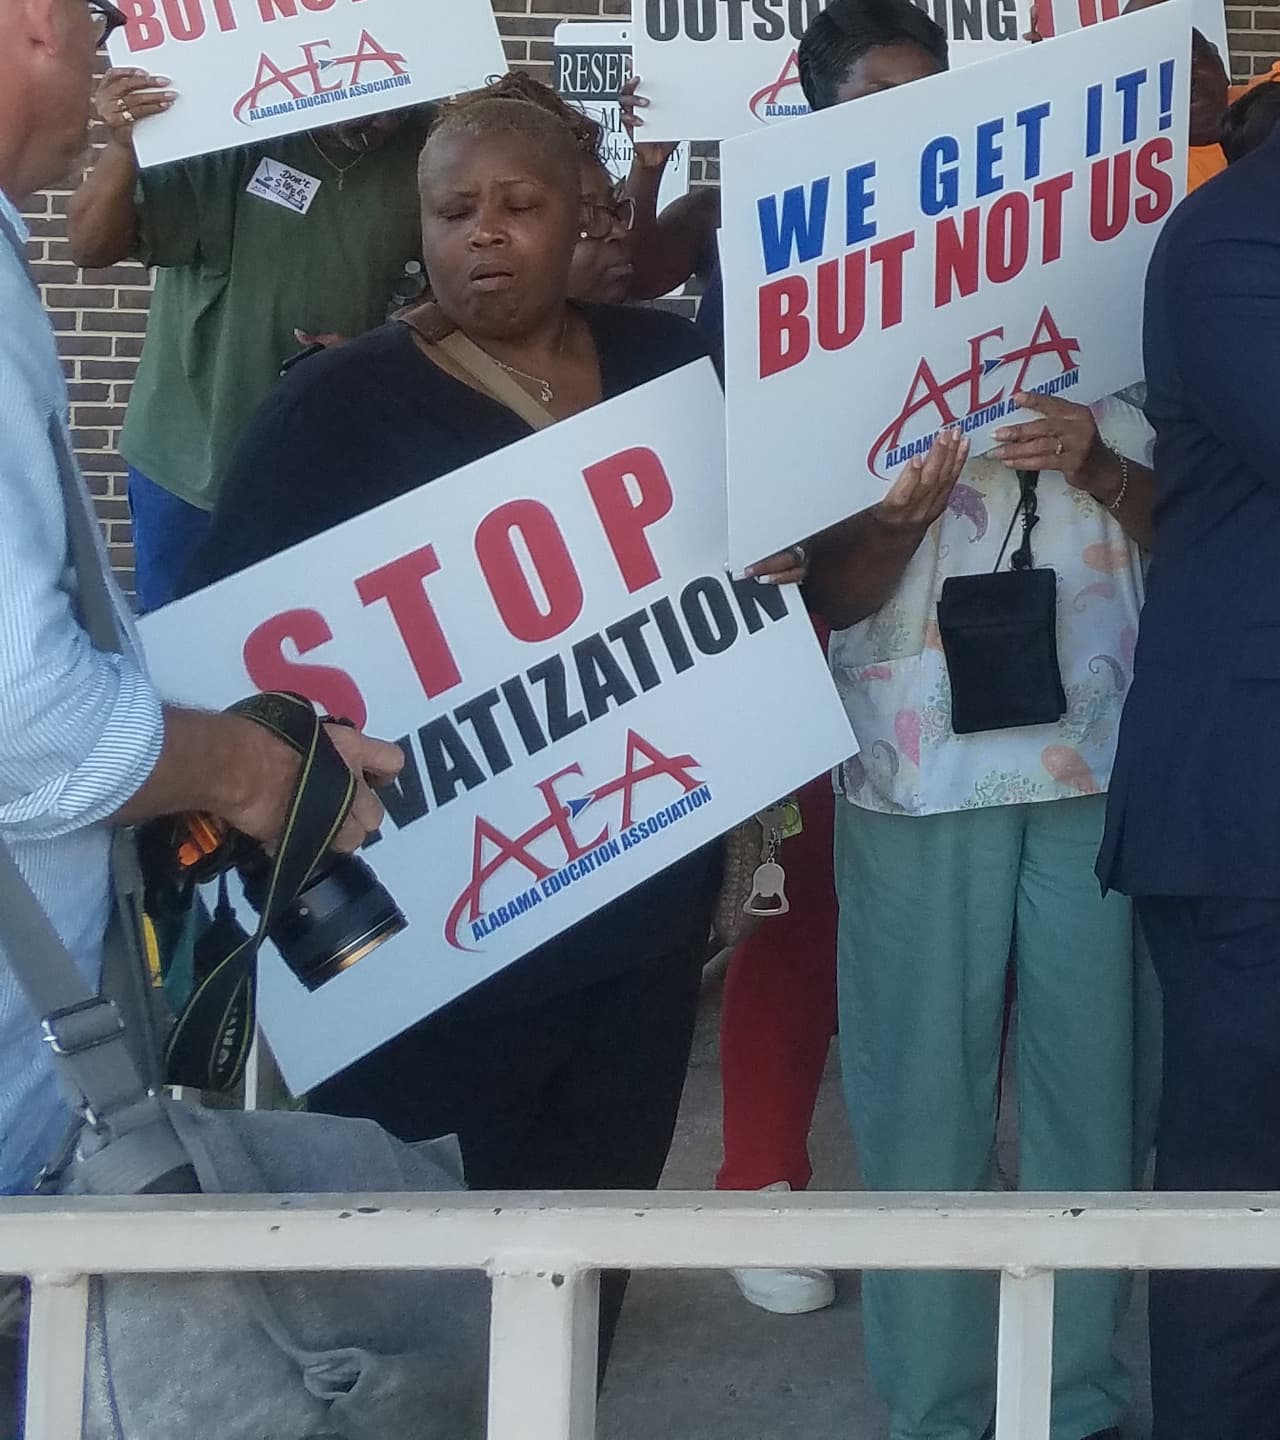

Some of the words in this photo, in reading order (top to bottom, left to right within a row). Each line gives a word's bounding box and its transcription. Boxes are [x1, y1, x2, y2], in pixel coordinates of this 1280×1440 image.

[240, 29, 409, 115] AEA
[249, 99, 295, 121] ALABAMA
[295, 87, 349, 111] EDUCATION
[349, 74, 411, 99] ASSOCIATION
[757, 160, 877, 276] WE
[919, 101, 1051, 217] GET
[1085, 58, 1176, 158] IT!
[758, 229, 916, 381] BUT
[934, 171, 1074, 309] NOT
[1089, 136, 1174, 243] US
[877, 304, 1081, 460] AEA
[242, 446, 674, 735] STOP
[362, 570, 790, 850] VATIZATION
[456, 728, 706, 932] AEA
[471, 887, 543, 942] ALABAMA
[542, 839, 621, 899] EDUCATION
[621, 785, 713, 852] ASSOCIATION
